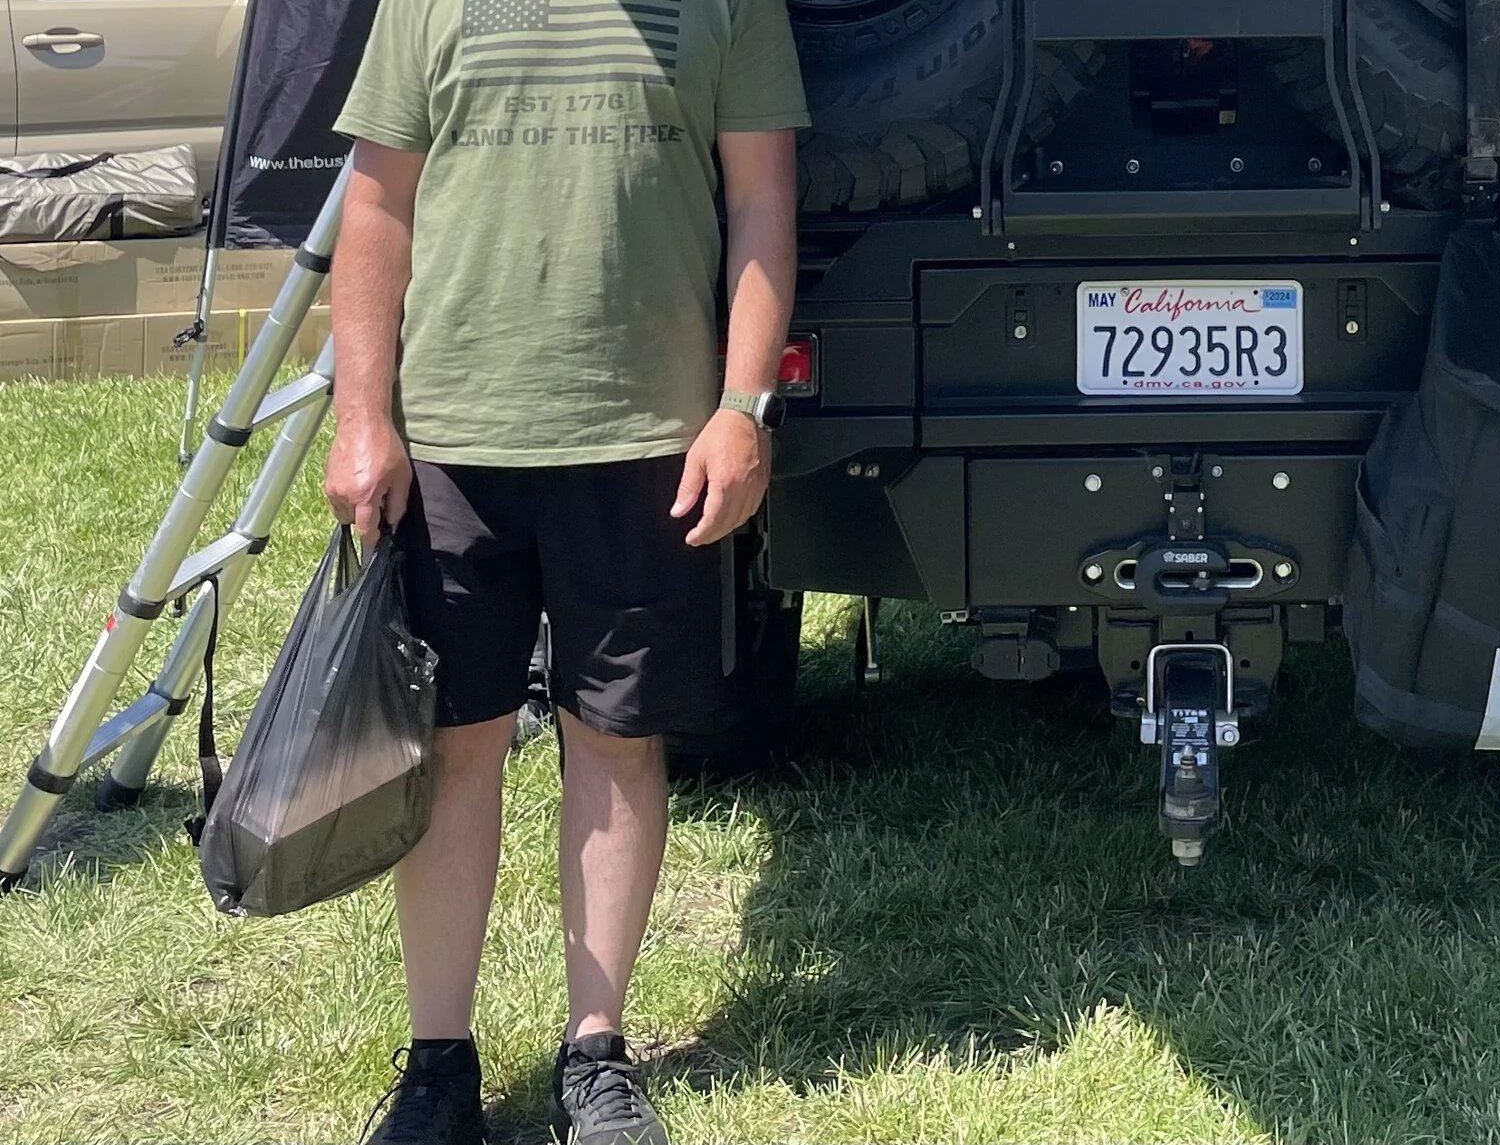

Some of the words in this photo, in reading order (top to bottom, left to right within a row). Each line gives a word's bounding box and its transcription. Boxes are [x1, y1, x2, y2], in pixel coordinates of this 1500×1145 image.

[504, 95, 553, 113] EST
[565, 93, 625, 113] 1776
[451, 128, 514, 147] LAND
[522, 127, 559, 146] OF
[565, 125, 617, 145] THE
[624, 123, 686, 144] FREE
[1088, 292, 1117, 307] MAY
[1123, 288, 1262, 321] California
[1269, 291, 1291, 301] 2024
[1093, 325, 1288, 377] 72935R3
[1133, 379, 1247, 389] dmv.ca.gov
[1174, 552, 1209, 564] SABER
